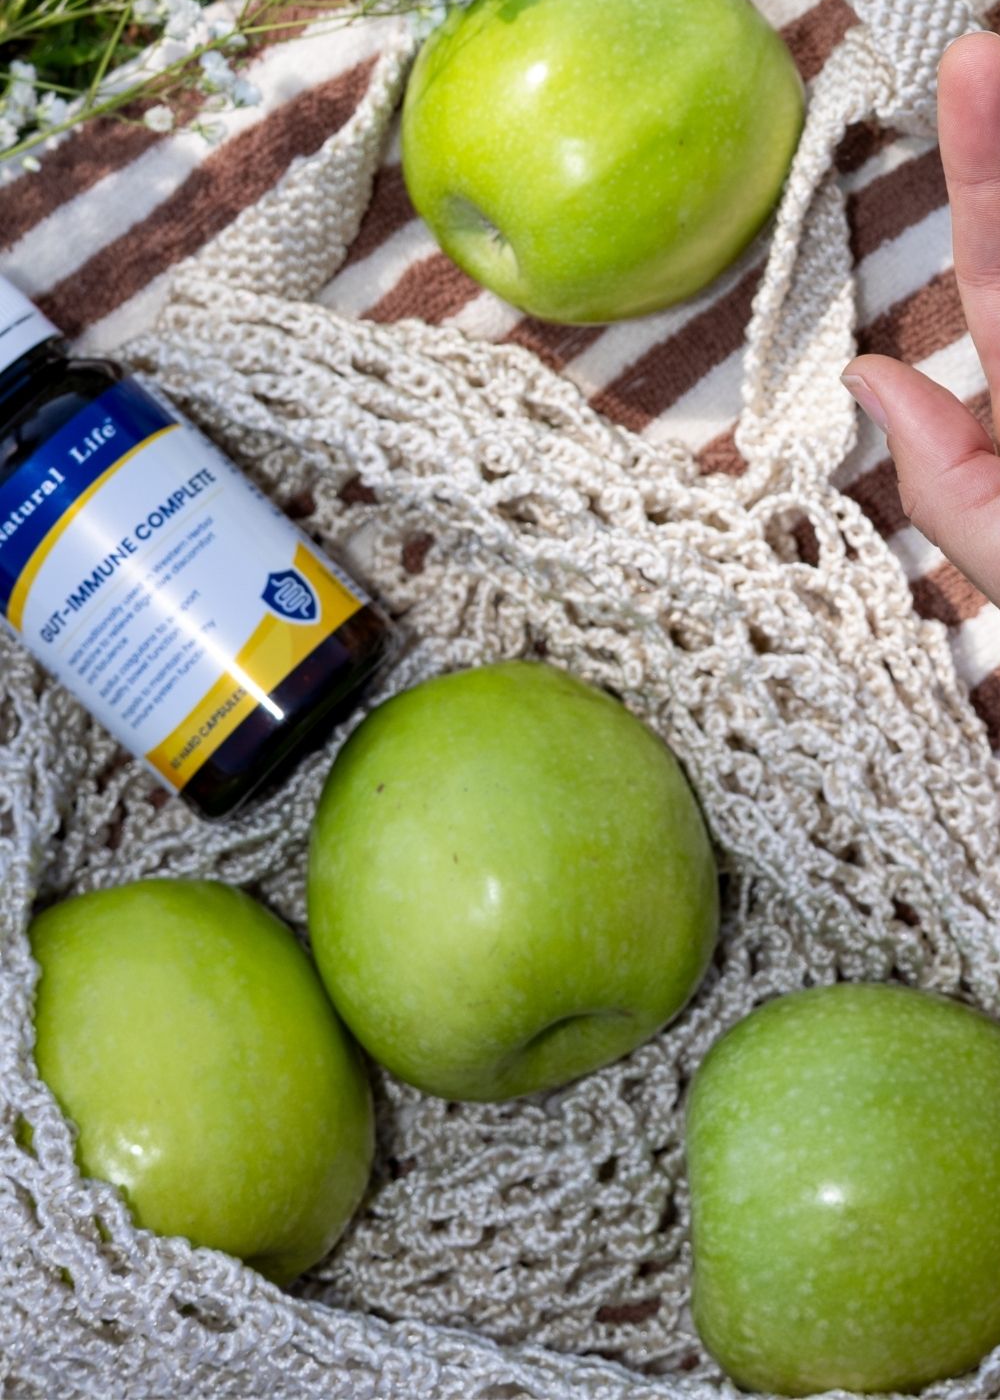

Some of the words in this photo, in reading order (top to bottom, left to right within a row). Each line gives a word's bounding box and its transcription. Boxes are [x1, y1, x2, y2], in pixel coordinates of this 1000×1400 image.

[40, 537, 138, 643] GUT-IMMUNE
[135, 468, 217, 540] COMPLETE
[199, 687, 248, 738] CAPSULES
